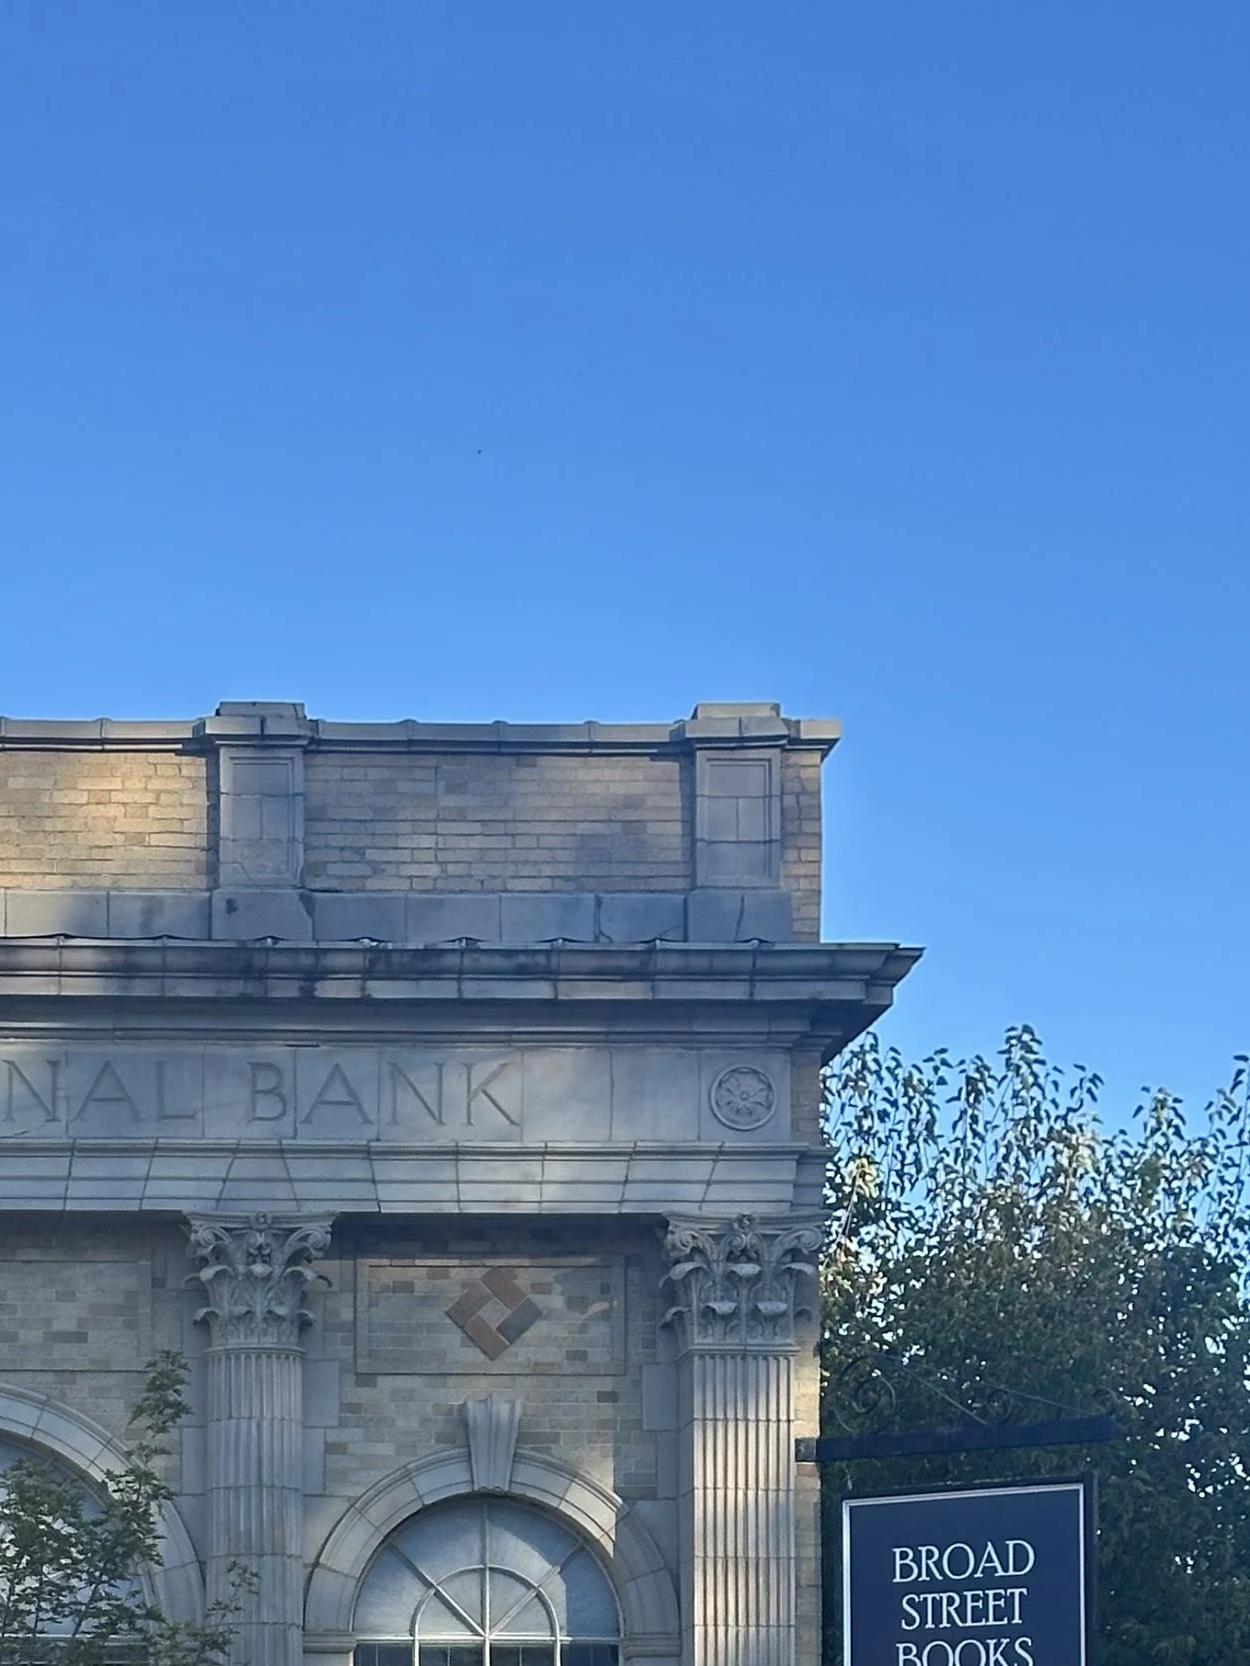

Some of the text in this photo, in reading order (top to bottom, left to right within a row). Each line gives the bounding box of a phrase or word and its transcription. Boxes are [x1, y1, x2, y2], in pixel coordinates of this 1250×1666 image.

[247, 1061, 520, 1127] BANK
[892, 1539, 1035, 1583] BROAD
[901, 1588, 1027, 1630] STREET
